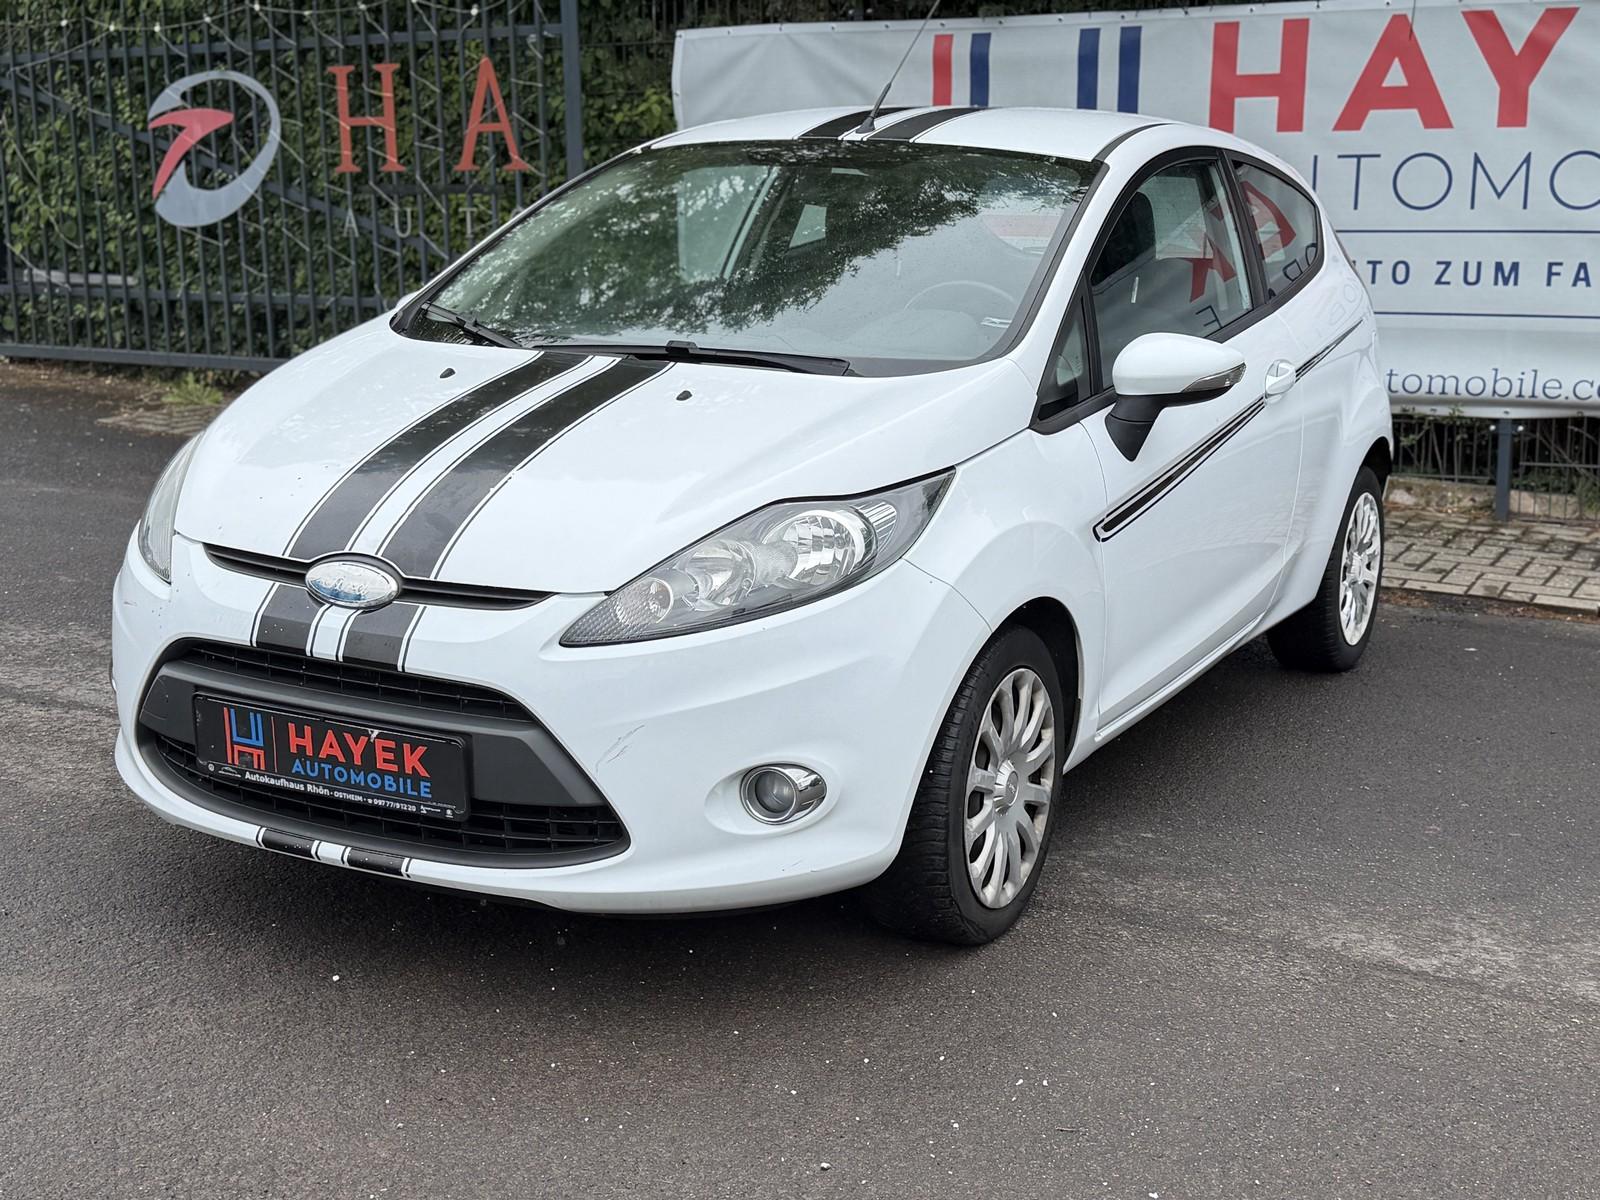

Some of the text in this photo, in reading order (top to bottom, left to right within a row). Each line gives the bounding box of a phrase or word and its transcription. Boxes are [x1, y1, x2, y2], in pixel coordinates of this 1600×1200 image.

[1208, 7, 1580, 133] HAY
[1352, 260, 1592, 288] TO ZUM FA
[1386, 368, 1600, 401] tomobile.c
[287, 722, 431, 778] HAYEK
[245, 771, 305, 791] Autokaufhaus
[291, 759, 433, 798] AUTOMOBILE
